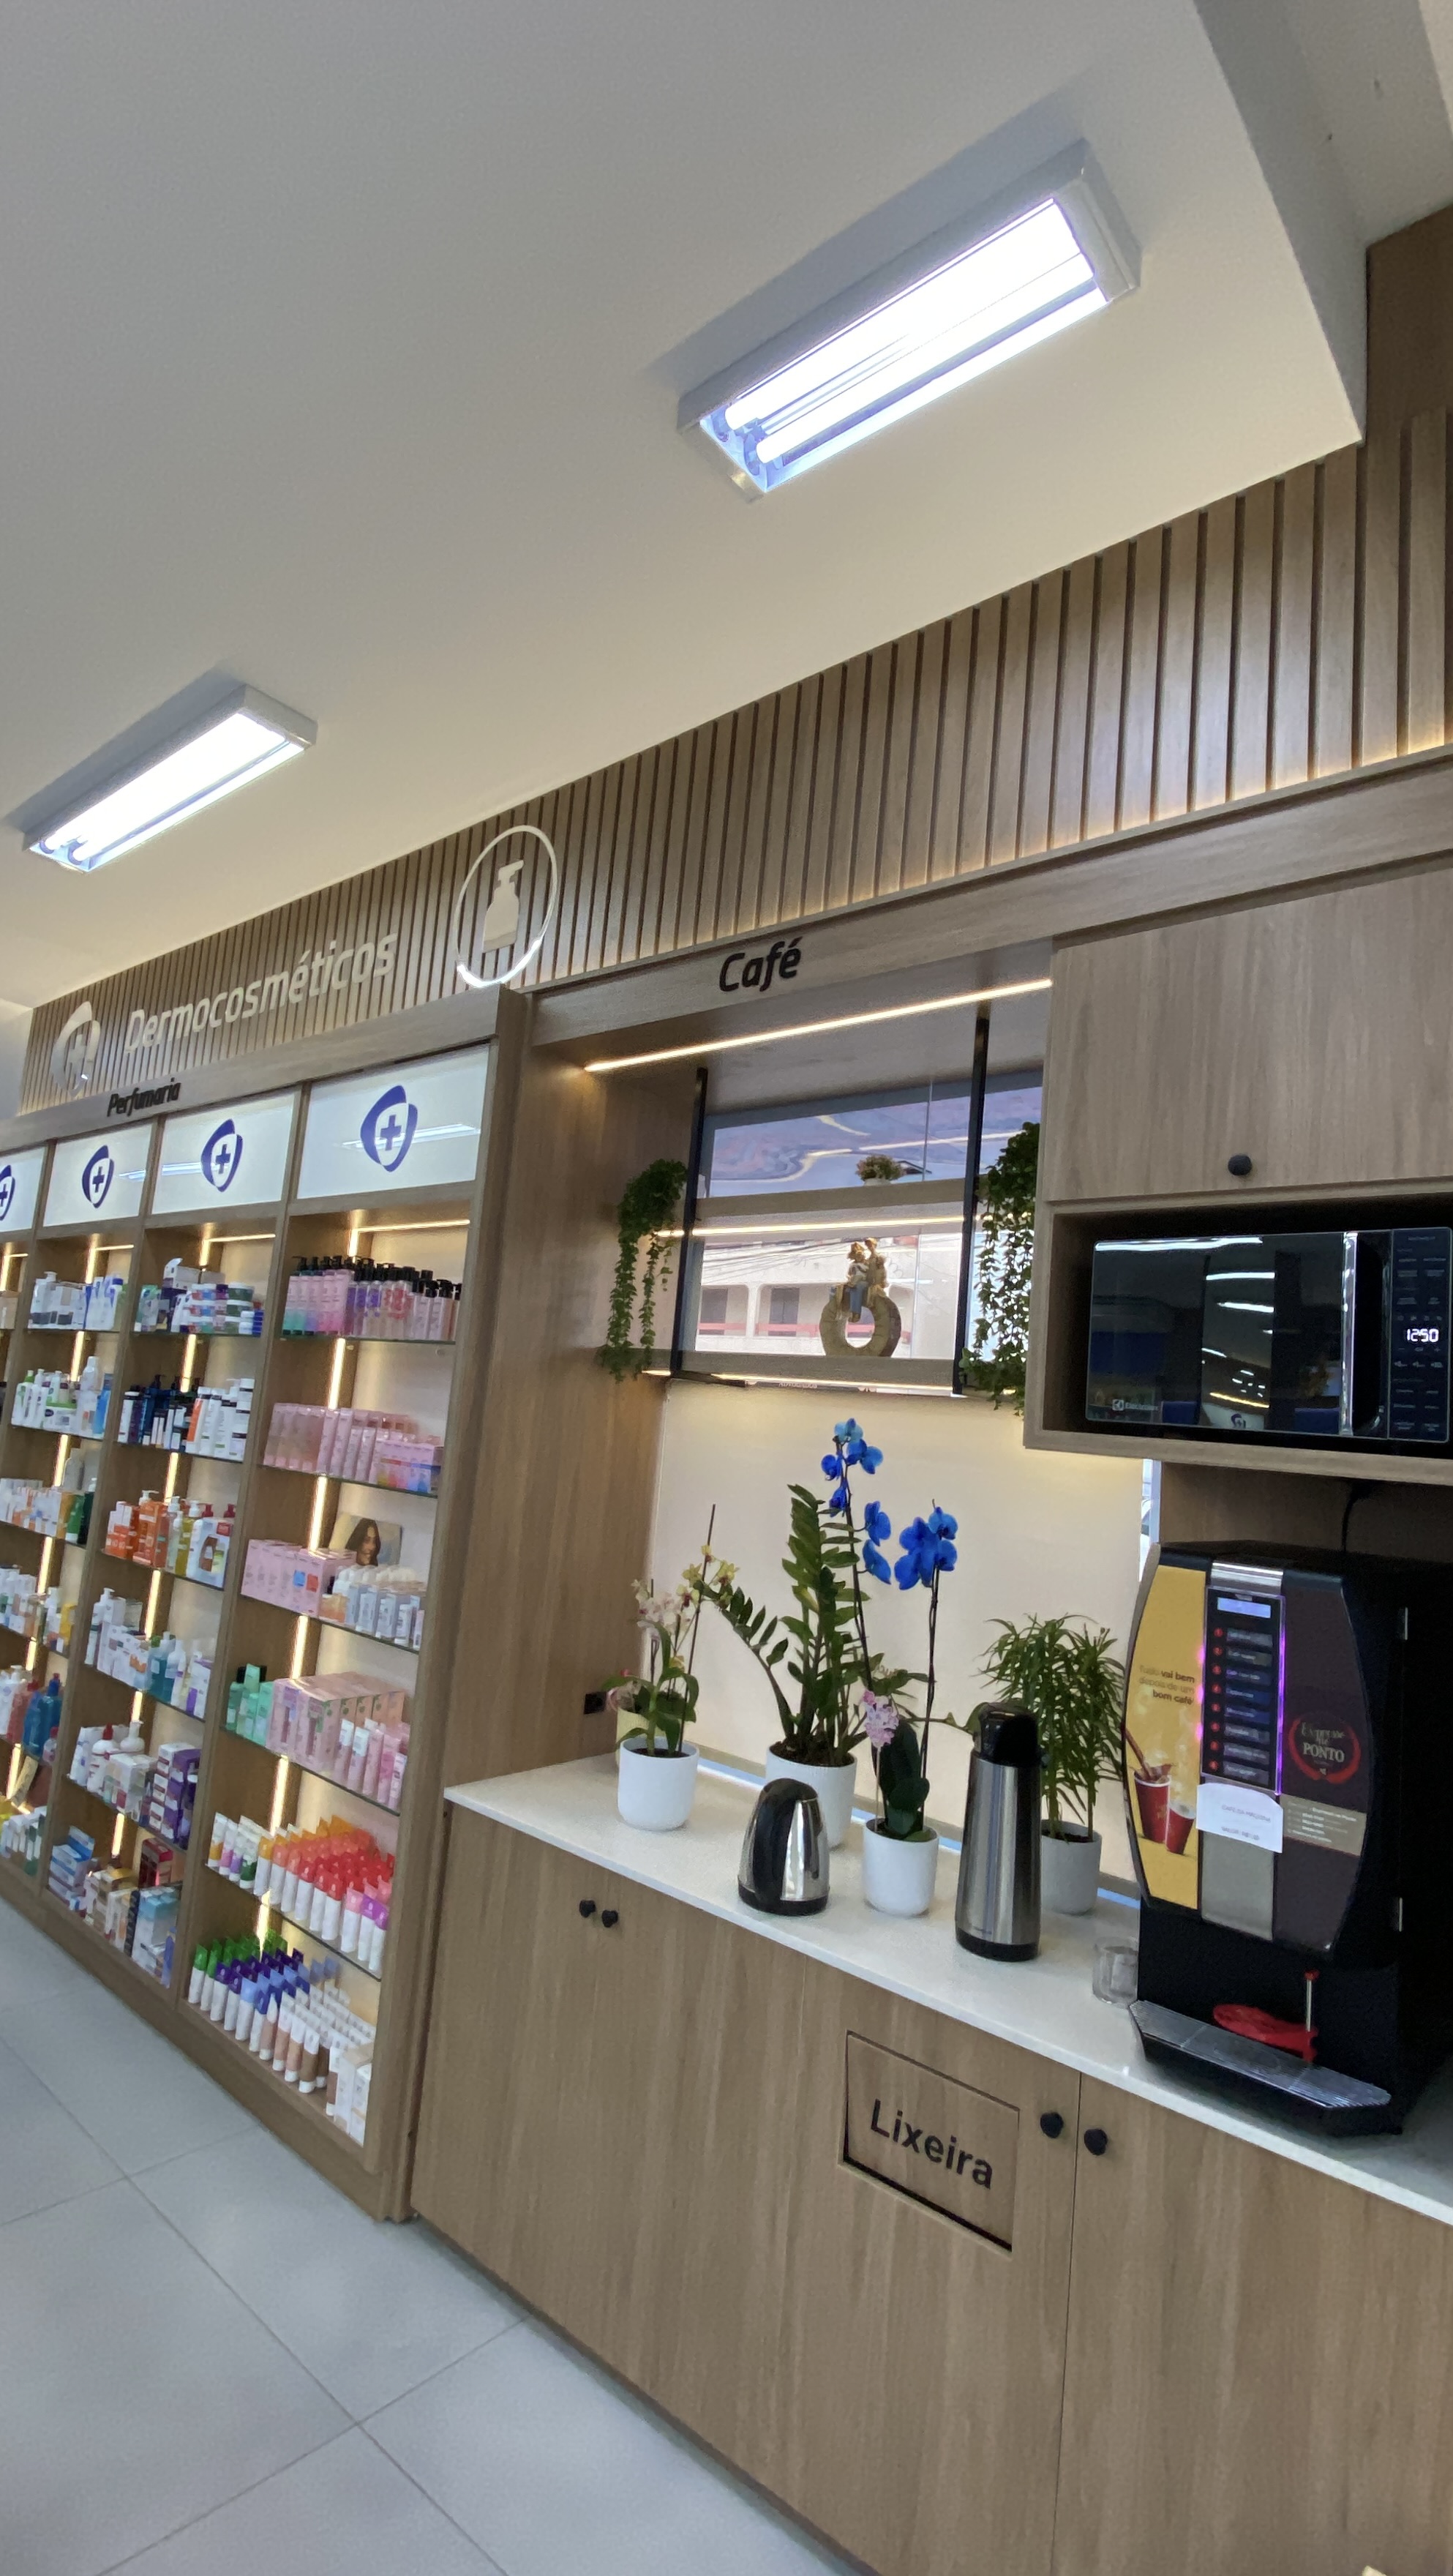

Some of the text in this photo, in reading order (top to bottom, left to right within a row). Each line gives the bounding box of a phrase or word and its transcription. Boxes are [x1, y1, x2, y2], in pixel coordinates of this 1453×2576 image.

[718, 936, 803, 992] Café
[124, 932, 398, 1054] Dermocosméticos
[107, 1077, 181, 1117] Perfumaria
[1152, 1689, 1194, 1705] bom café
[1161, 1671, 1174, 1679] vai
[1175, 1671, 1195, 1684] bem
[1303, 1742, 1345, 1763] PONTO
[871, 2098, 993, 2190] Lixeira
